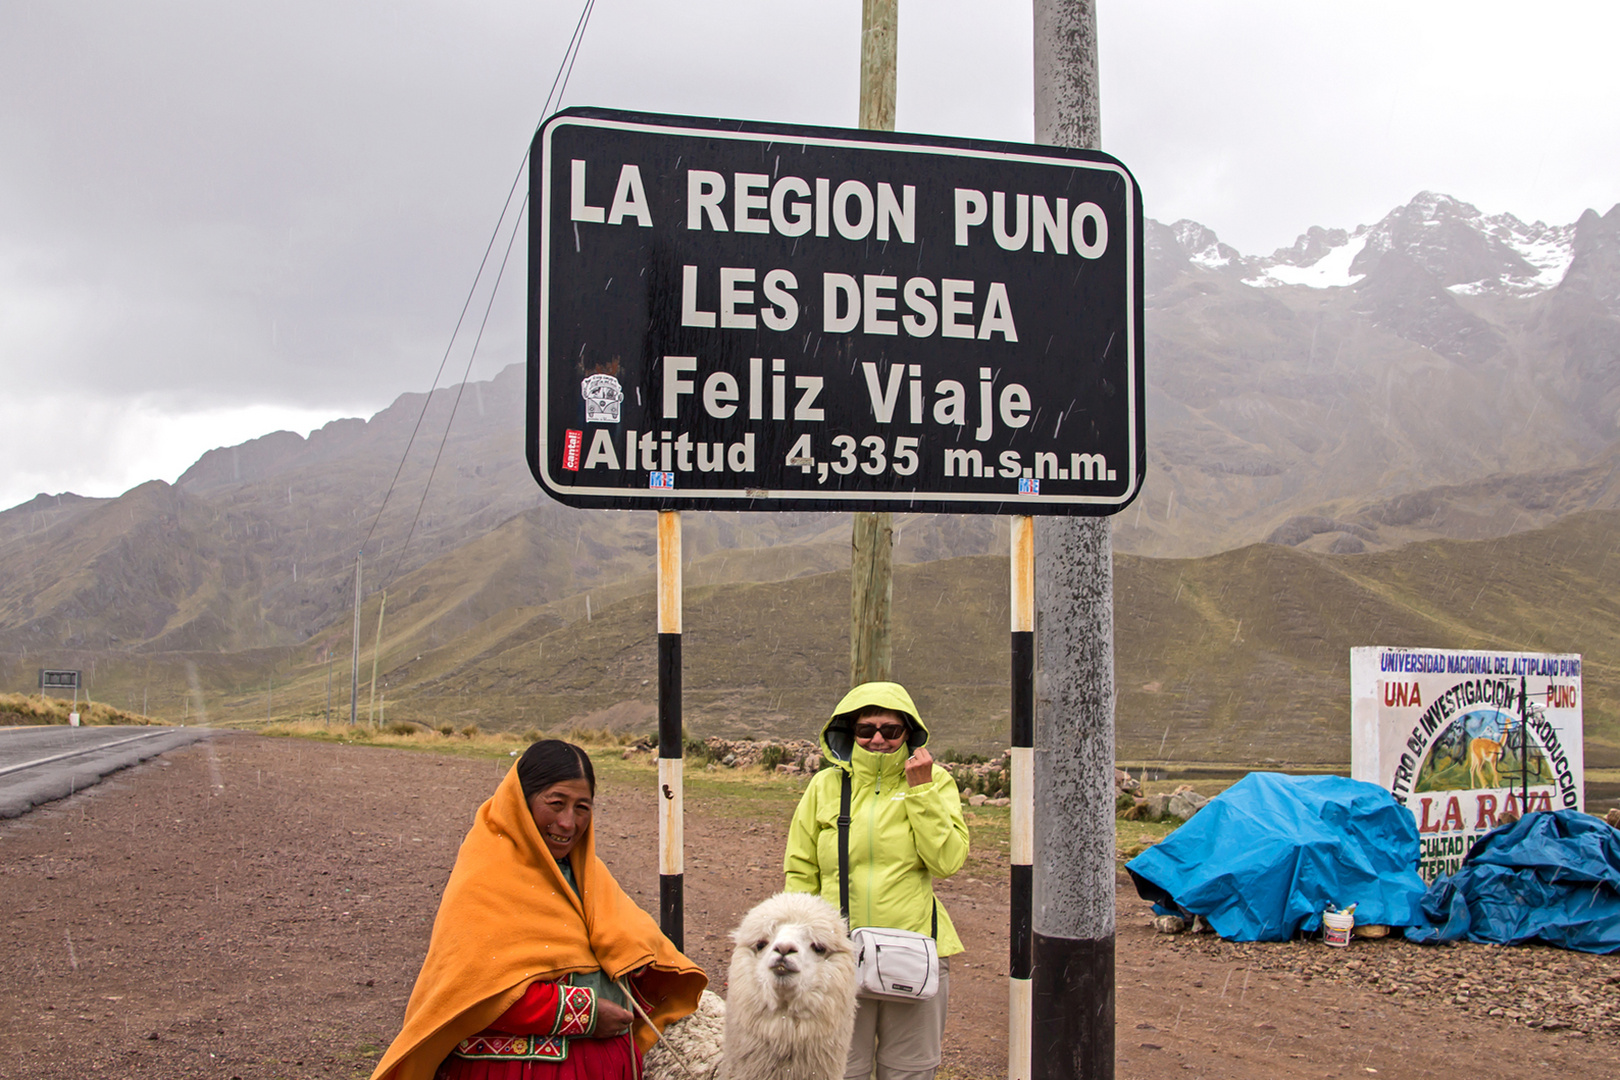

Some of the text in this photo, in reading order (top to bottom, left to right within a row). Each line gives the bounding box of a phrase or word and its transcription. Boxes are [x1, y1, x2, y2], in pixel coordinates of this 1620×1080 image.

[571, 159, 1109, 260] LA REGION PUNO
[681, 264, 1019, 343] LES DESEA
[662, 355, 1032, 442] Feliz Viaje
[584, 428, 1118, 484] Altitud 4,335 m.s.n.m.
[1381, 652, 1580, 677] UNIVERSIDAD NACIONAL DEL ALTIPLANO PUNO
[1384, 681, 1422, 708] UNA
[1419, 678, 1515, 738] INVESTIGACION
[1546, 684, 1576, 709] PUNO
[1418, 796, 1465, 834] LA
[1467, 834, 1484, 852] D
